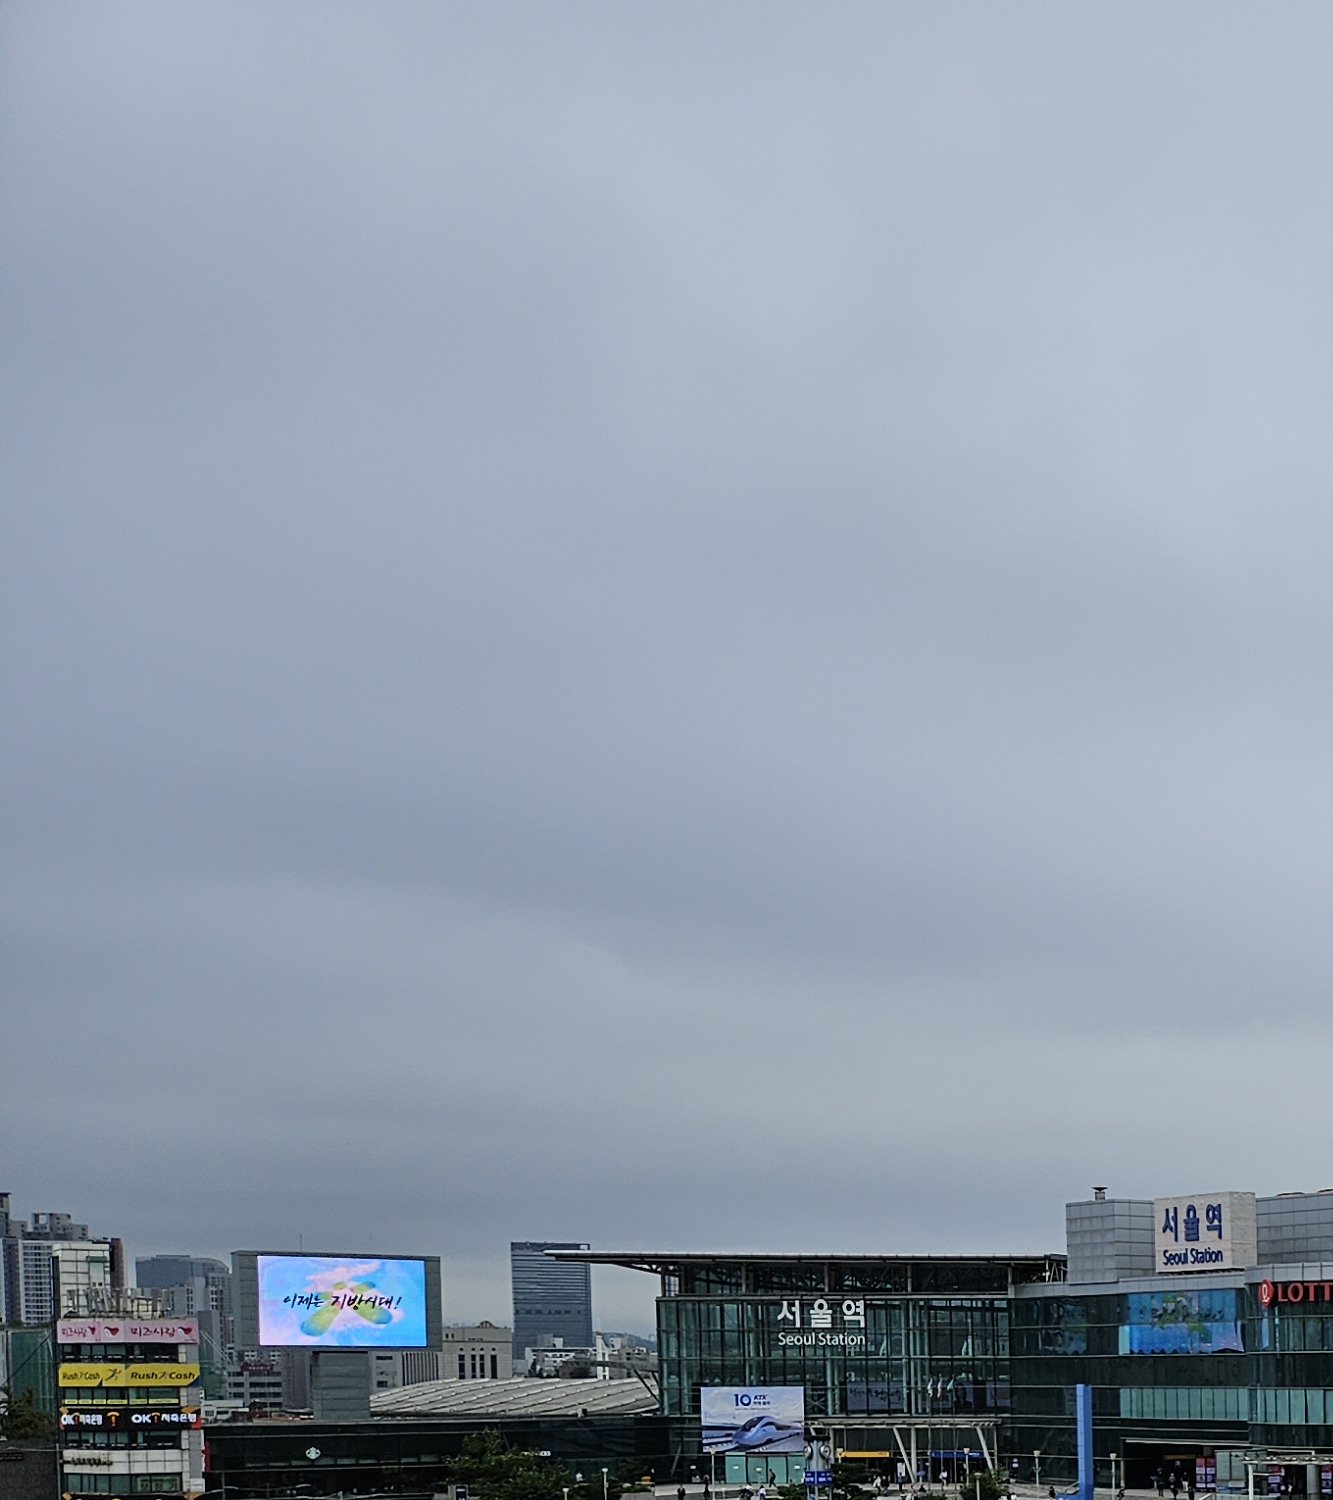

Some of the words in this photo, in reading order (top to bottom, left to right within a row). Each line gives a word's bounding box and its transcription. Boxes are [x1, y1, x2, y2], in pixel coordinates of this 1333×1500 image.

[1162, 1203, 1223, 1242] 서울역
[1163, 1250, 1189, 1266] Seoul
[1190, 1247, 1223, 1264] Station
[284, 1292, 324, 1311] 이제는
[331, 1294, 402, 1311] 지방시대!
[777, 1299, 866, 1329] 서울역
[130, 1327, 176, 1338] 미즈사랑
[778, 1332, 815, 1346] Seoul
[818, 1332, 866, 1346] Station
[62, 1371, 79, 1381] Rush
[84, 1371, 100, 1381] Cash
[131, 1371, 159, 1380] Rush
[169, 1371, 196, 1380] Cash
[733, 1393, 752, 1407] 10
[61, 1414, 75, 1426] OK
[131, 1414, 151, 1424] OK
